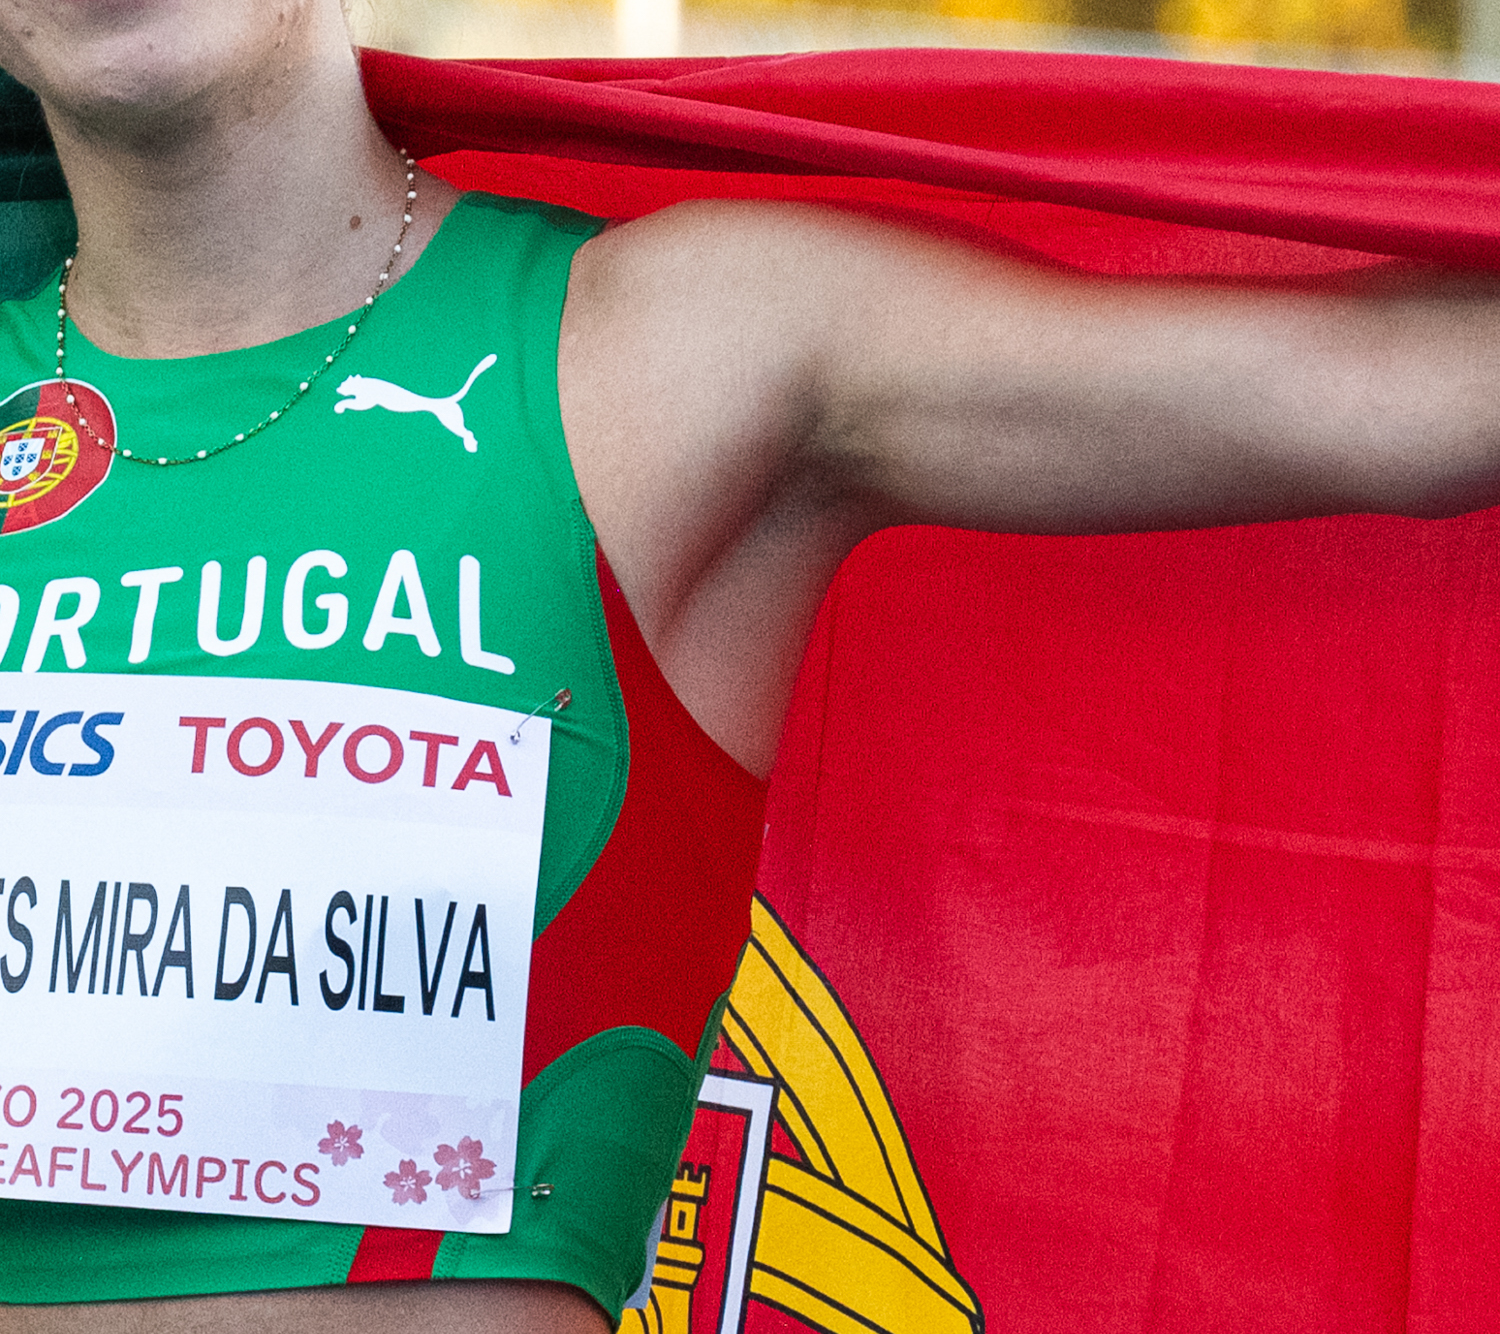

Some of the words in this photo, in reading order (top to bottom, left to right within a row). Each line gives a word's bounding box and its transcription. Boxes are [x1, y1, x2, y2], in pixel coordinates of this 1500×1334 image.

[178, 715, 513, 798] TOYOTA
[48, 878, 195, 1000] MIRA
[213, 885, 300, 1007] DA
[318, 889, 496, 1022] SILVA
[56, 1086, 184, 1138] 2025
